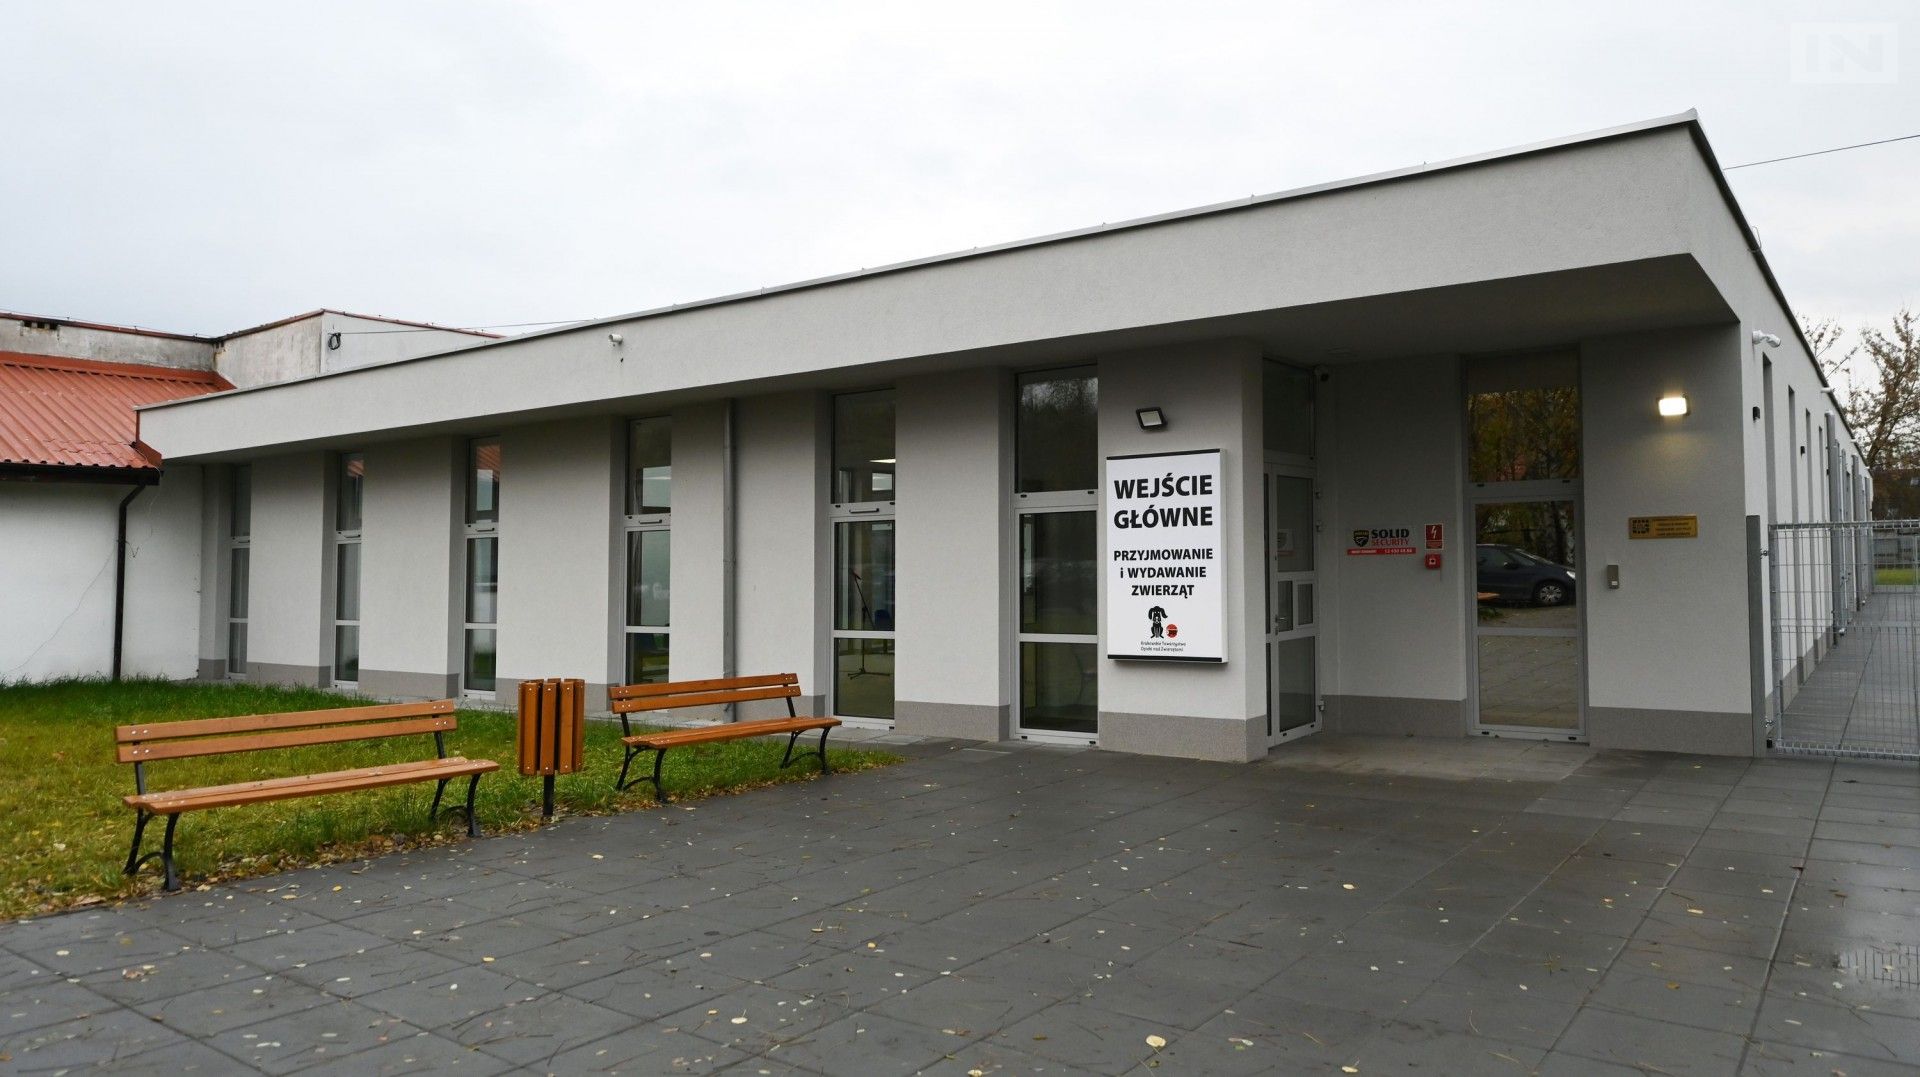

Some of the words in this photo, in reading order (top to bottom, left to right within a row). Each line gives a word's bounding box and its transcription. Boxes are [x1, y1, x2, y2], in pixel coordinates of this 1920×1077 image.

[1114, 473, 1213, 499] WEJŚCIE
[1114, 505, 1213, 529] GŁÓWNE
[1371, 528, 1410, 539] SOLID
[1371, 538, 1409, 546] SECURITY
[1114, 548, 1213, 561] PRZYJMOWANIE
[1120, 567, 1124, 578] i
[1127, 567, 1207, 578] WYDAWANIE
[1131, 584, 1195, 599] ZWIERZĄT
